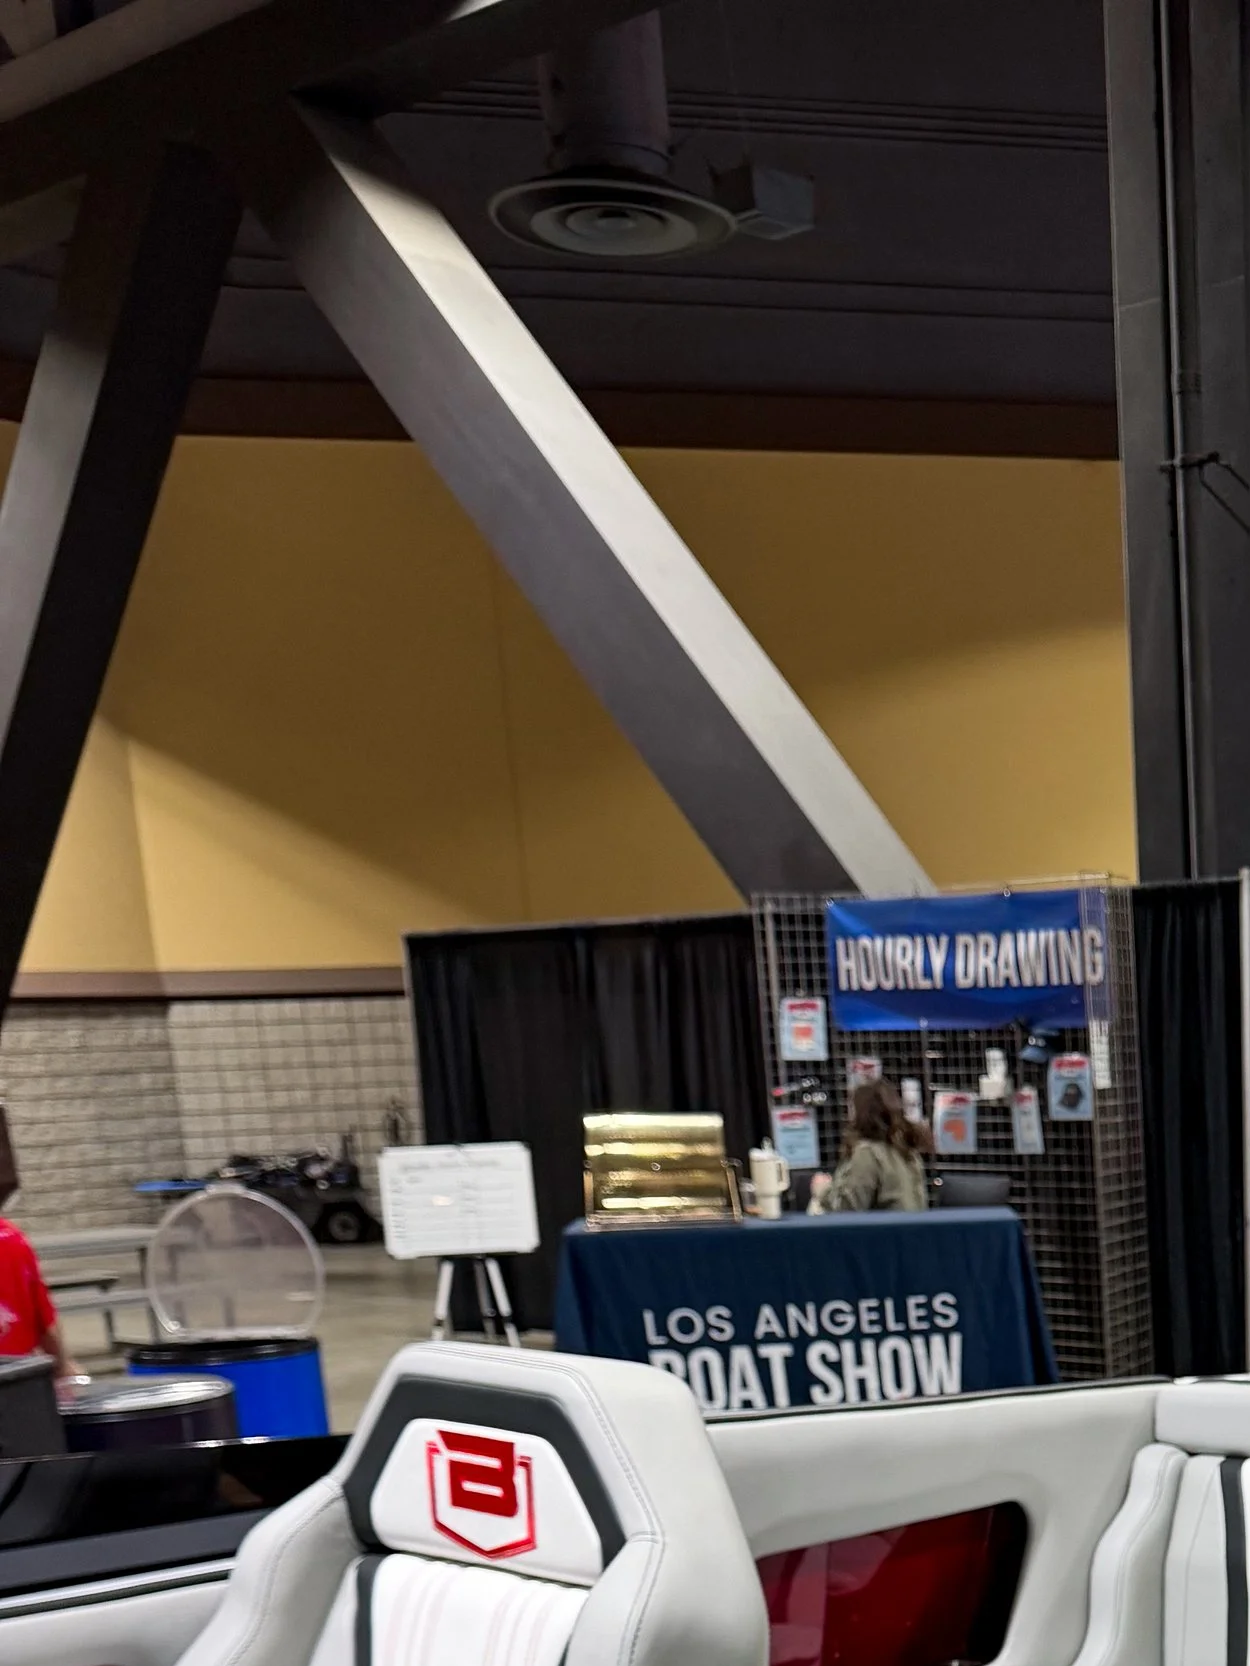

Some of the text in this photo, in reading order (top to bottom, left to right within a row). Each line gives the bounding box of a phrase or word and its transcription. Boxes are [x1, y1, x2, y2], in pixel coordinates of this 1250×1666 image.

[835, 925, 1107, 991] HOURLY DRAWING
[642, 1292, 960, 1347] LOS ANGELES
[805, 1332, 964, 1407] SHOW
